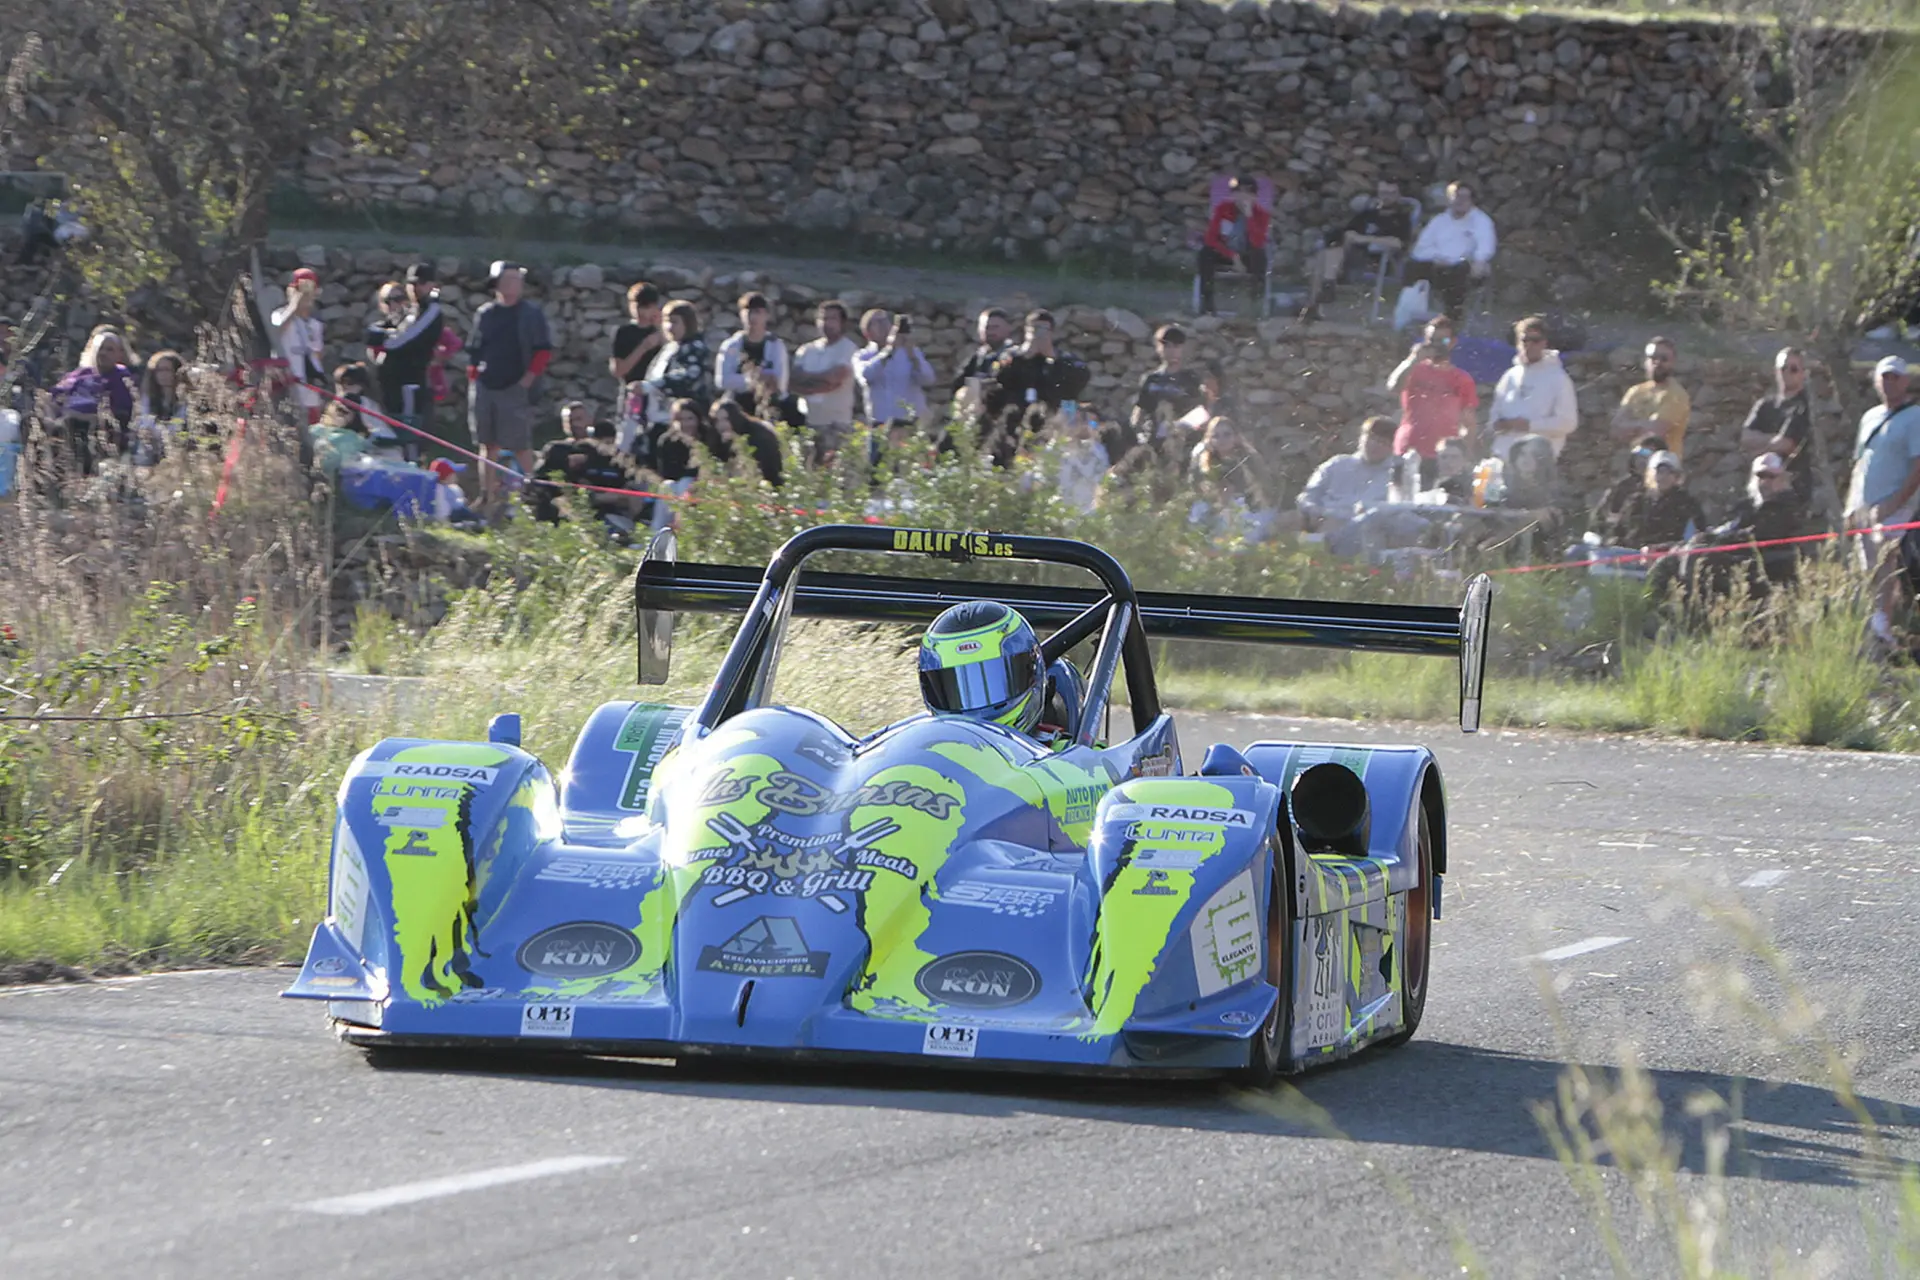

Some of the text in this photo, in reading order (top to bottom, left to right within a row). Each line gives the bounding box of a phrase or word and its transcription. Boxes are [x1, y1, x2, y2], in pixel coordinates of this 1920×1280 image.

[959, 643, 979, 651] BELL
[394, 765, 488, 780] RADSA
[1150, 807, 1247, 824] RADSA
[757, 824, 842, 848] Premium
[684, 848, 733, 863] arnes
[855, 850, 917, 877] Meats
[703, 867, 874, 897] BBQ & Grill
[541, 952, 612, 966] KUN
[1221, 943, 1255, 963] ELEGANTE
[940, 979, 1010, 997] KUN
[526, 1005, 571, 1021] OPB
[929, 1026, 974, 1041] OPB
